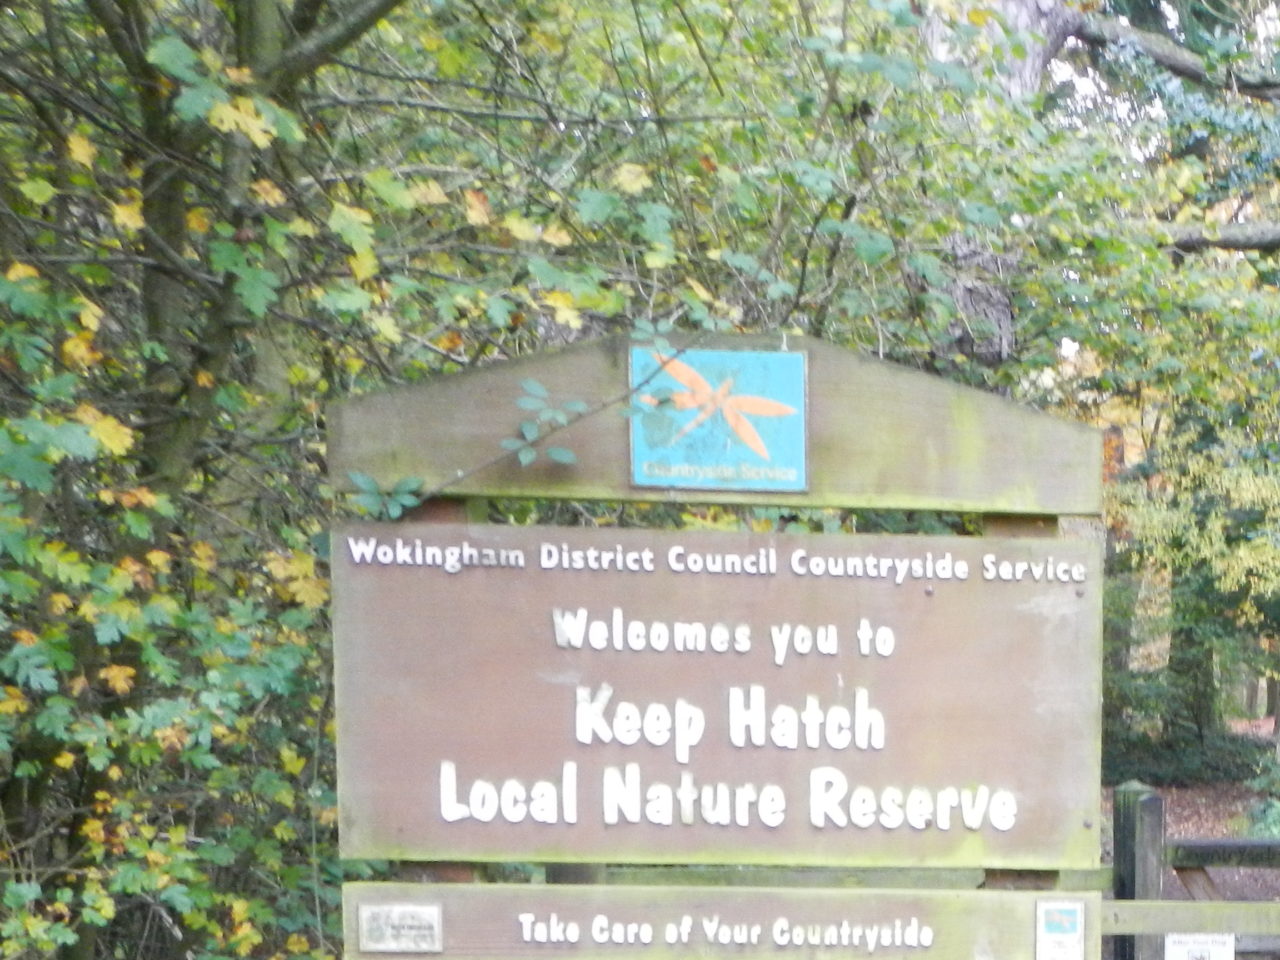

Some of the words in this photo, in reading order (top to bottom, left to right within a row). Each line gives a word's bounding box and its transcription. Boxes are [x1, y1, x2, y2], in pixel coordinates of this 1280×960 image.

[347, 537, 525, 574] Wokingham
[540, 543, 655, 571] District
[667, 546, 777, 575] Council
[790, 549, 969, 584] Countryside
[981, 553, 1086, 582] Service
[552, 607, 751, 654] Welcomes
[770, 622, 838, 666] you
[857, 618, 896, 656] to
[575, 682, 706, 764] Keep
[729, 684, 886, 750] Hatch
[439, 759, 578, 824] Local
[602, 762, 786, 828] Nature
[809, 766, 1018, 832] Reserve
[518, 912, 581, 944] Take
[590, 914, 654, 945] Care
[664, 914, 693, 944] of
[702, 915, 761, 946] Your
[771, 916, 934, 953] Countryside
